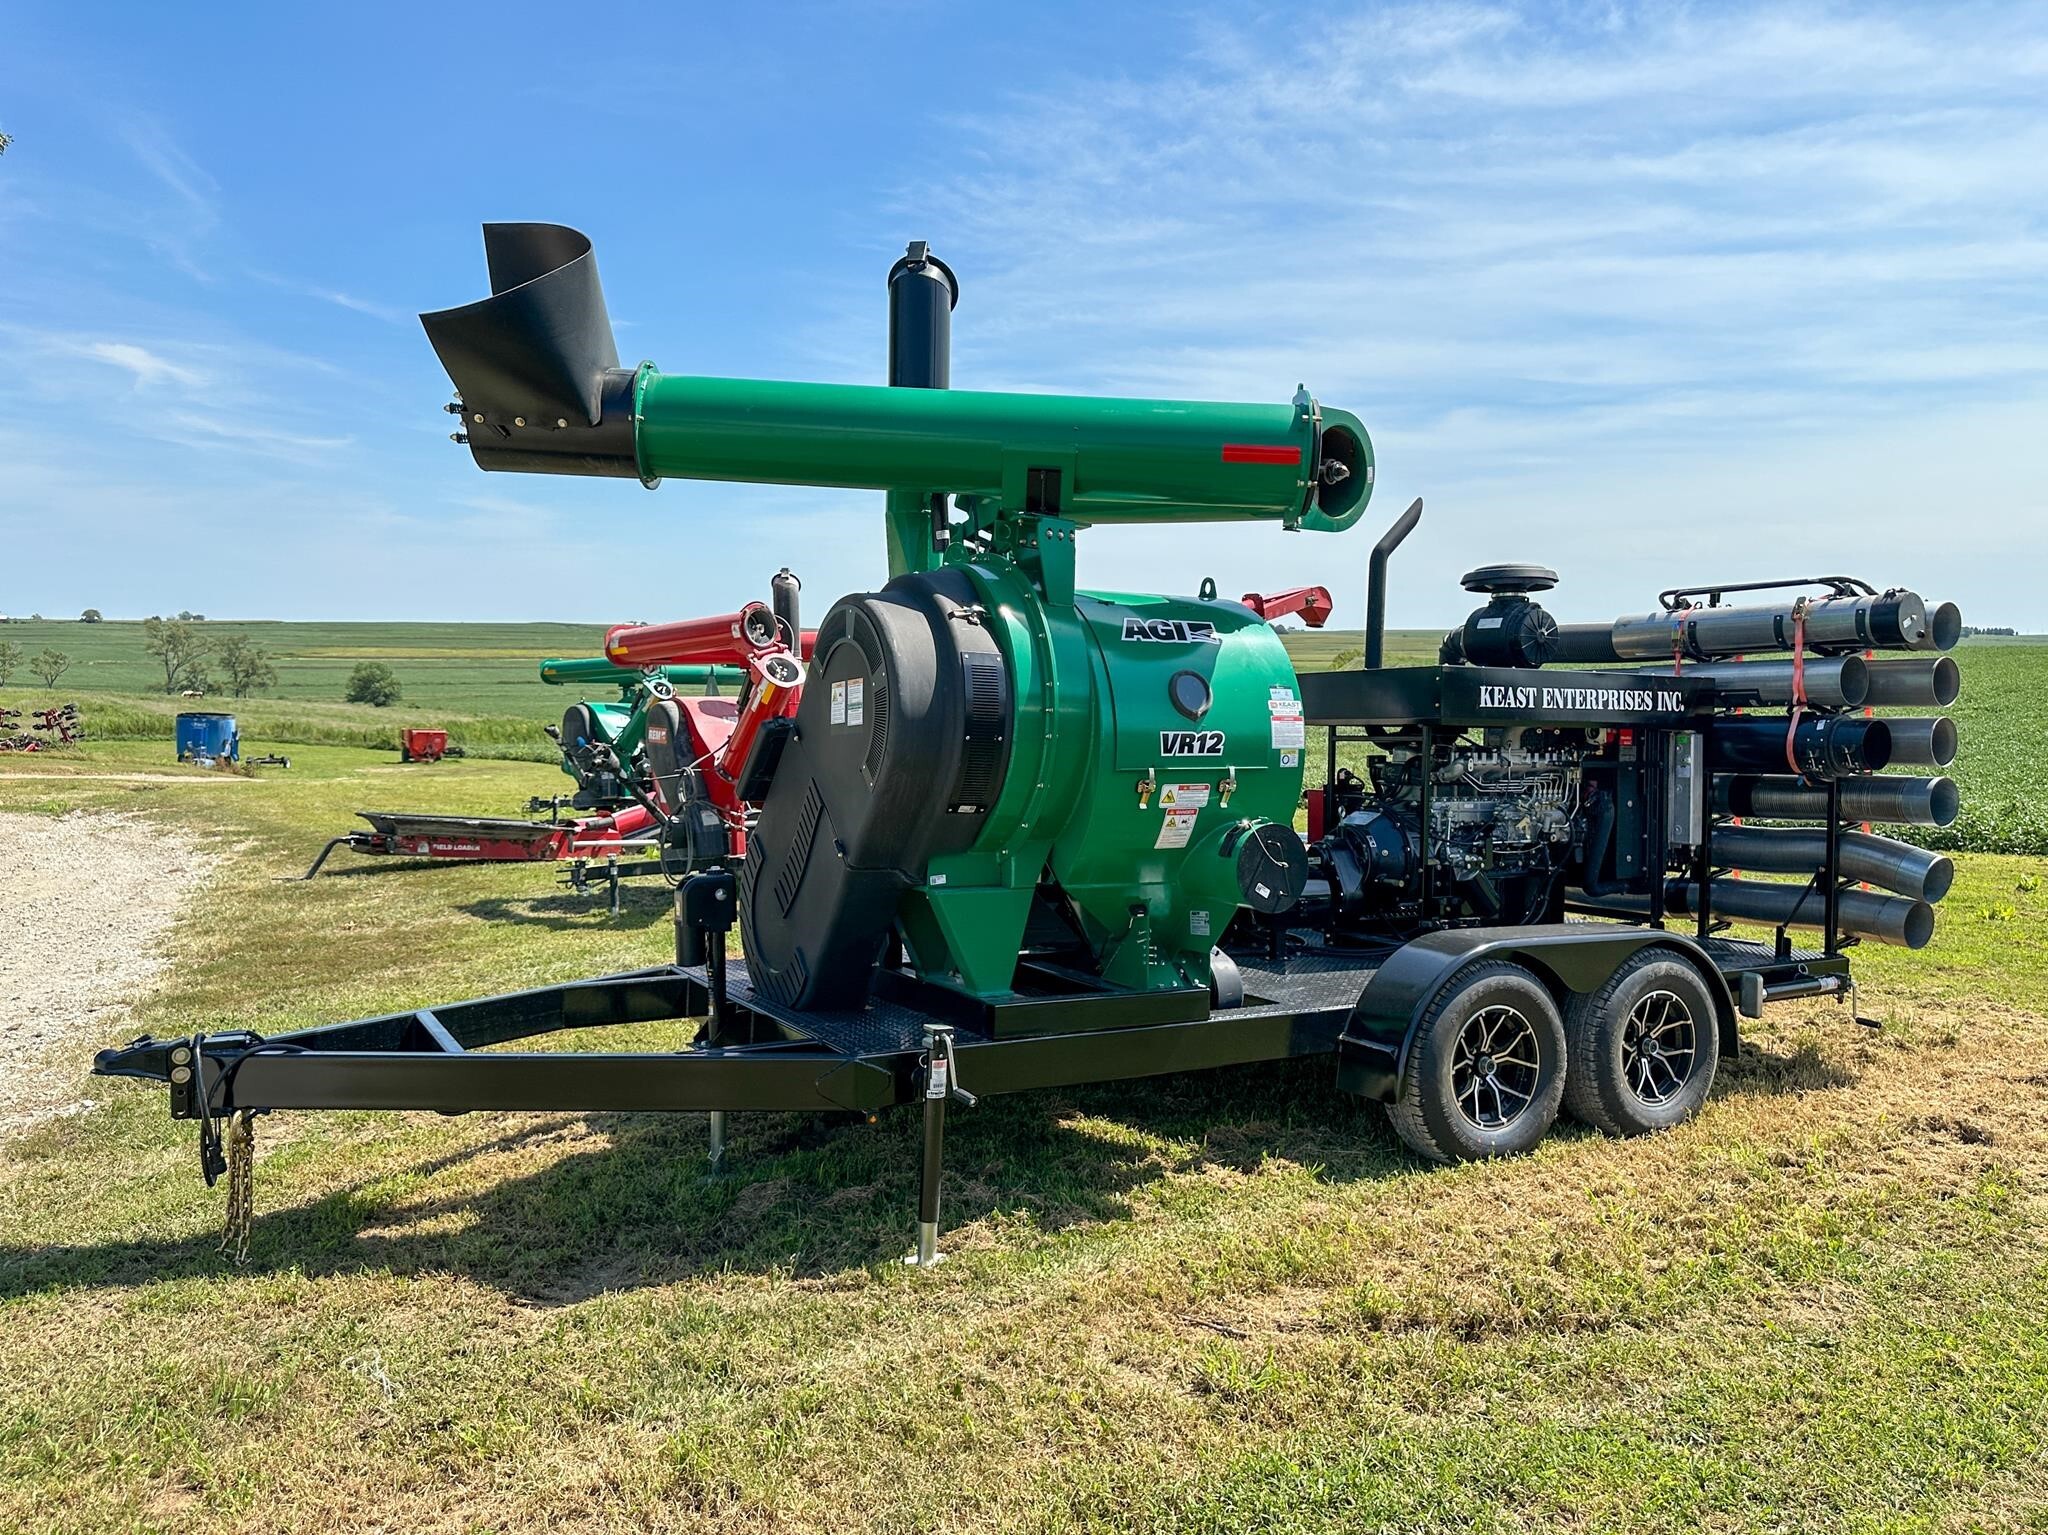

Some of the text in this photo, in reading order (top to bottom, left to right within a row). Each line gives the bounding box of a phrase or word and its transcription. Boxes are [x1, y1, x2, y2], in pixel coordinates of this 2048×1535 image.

[1122, 617, 1191, 643] AGI
[1479, 685, 1685, 712] KEAST ENTERPRISES INC.
[1160, 731, 1225, 756] VR12
